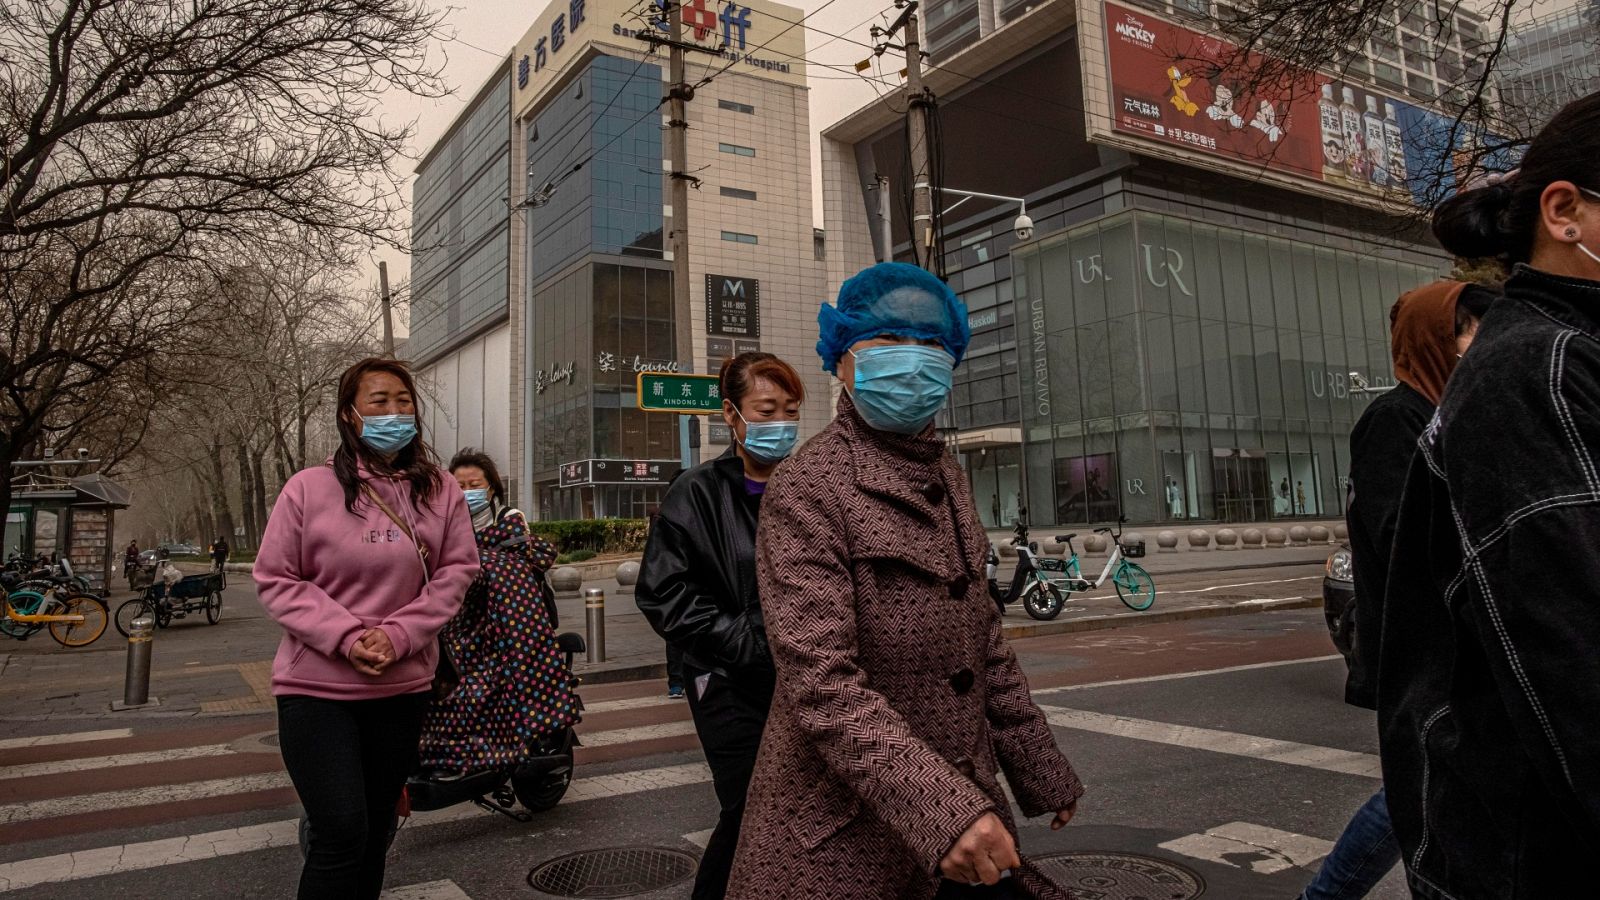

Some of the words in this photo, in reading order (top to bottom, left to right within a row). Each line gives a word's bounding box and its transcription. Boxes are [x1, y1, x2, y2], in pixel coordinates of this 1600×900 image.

[1115, 22, 1155, 44] MICKEY
[745, 54, 790, 73] Hospital
[1124, 98, 1160, 117] 元气森林
[968, 312, 996, 328] Haskoll
[1031, 298, 1046, 354] URBAN
[652, 382, 720, 399] 新东路
[1035, 357, 1050, 417] REVIVO
[664, 398, 697, 406] XINDONG
[1127, 478, 1146, 495] UR
[361, 529, 400, 544] NEVER
